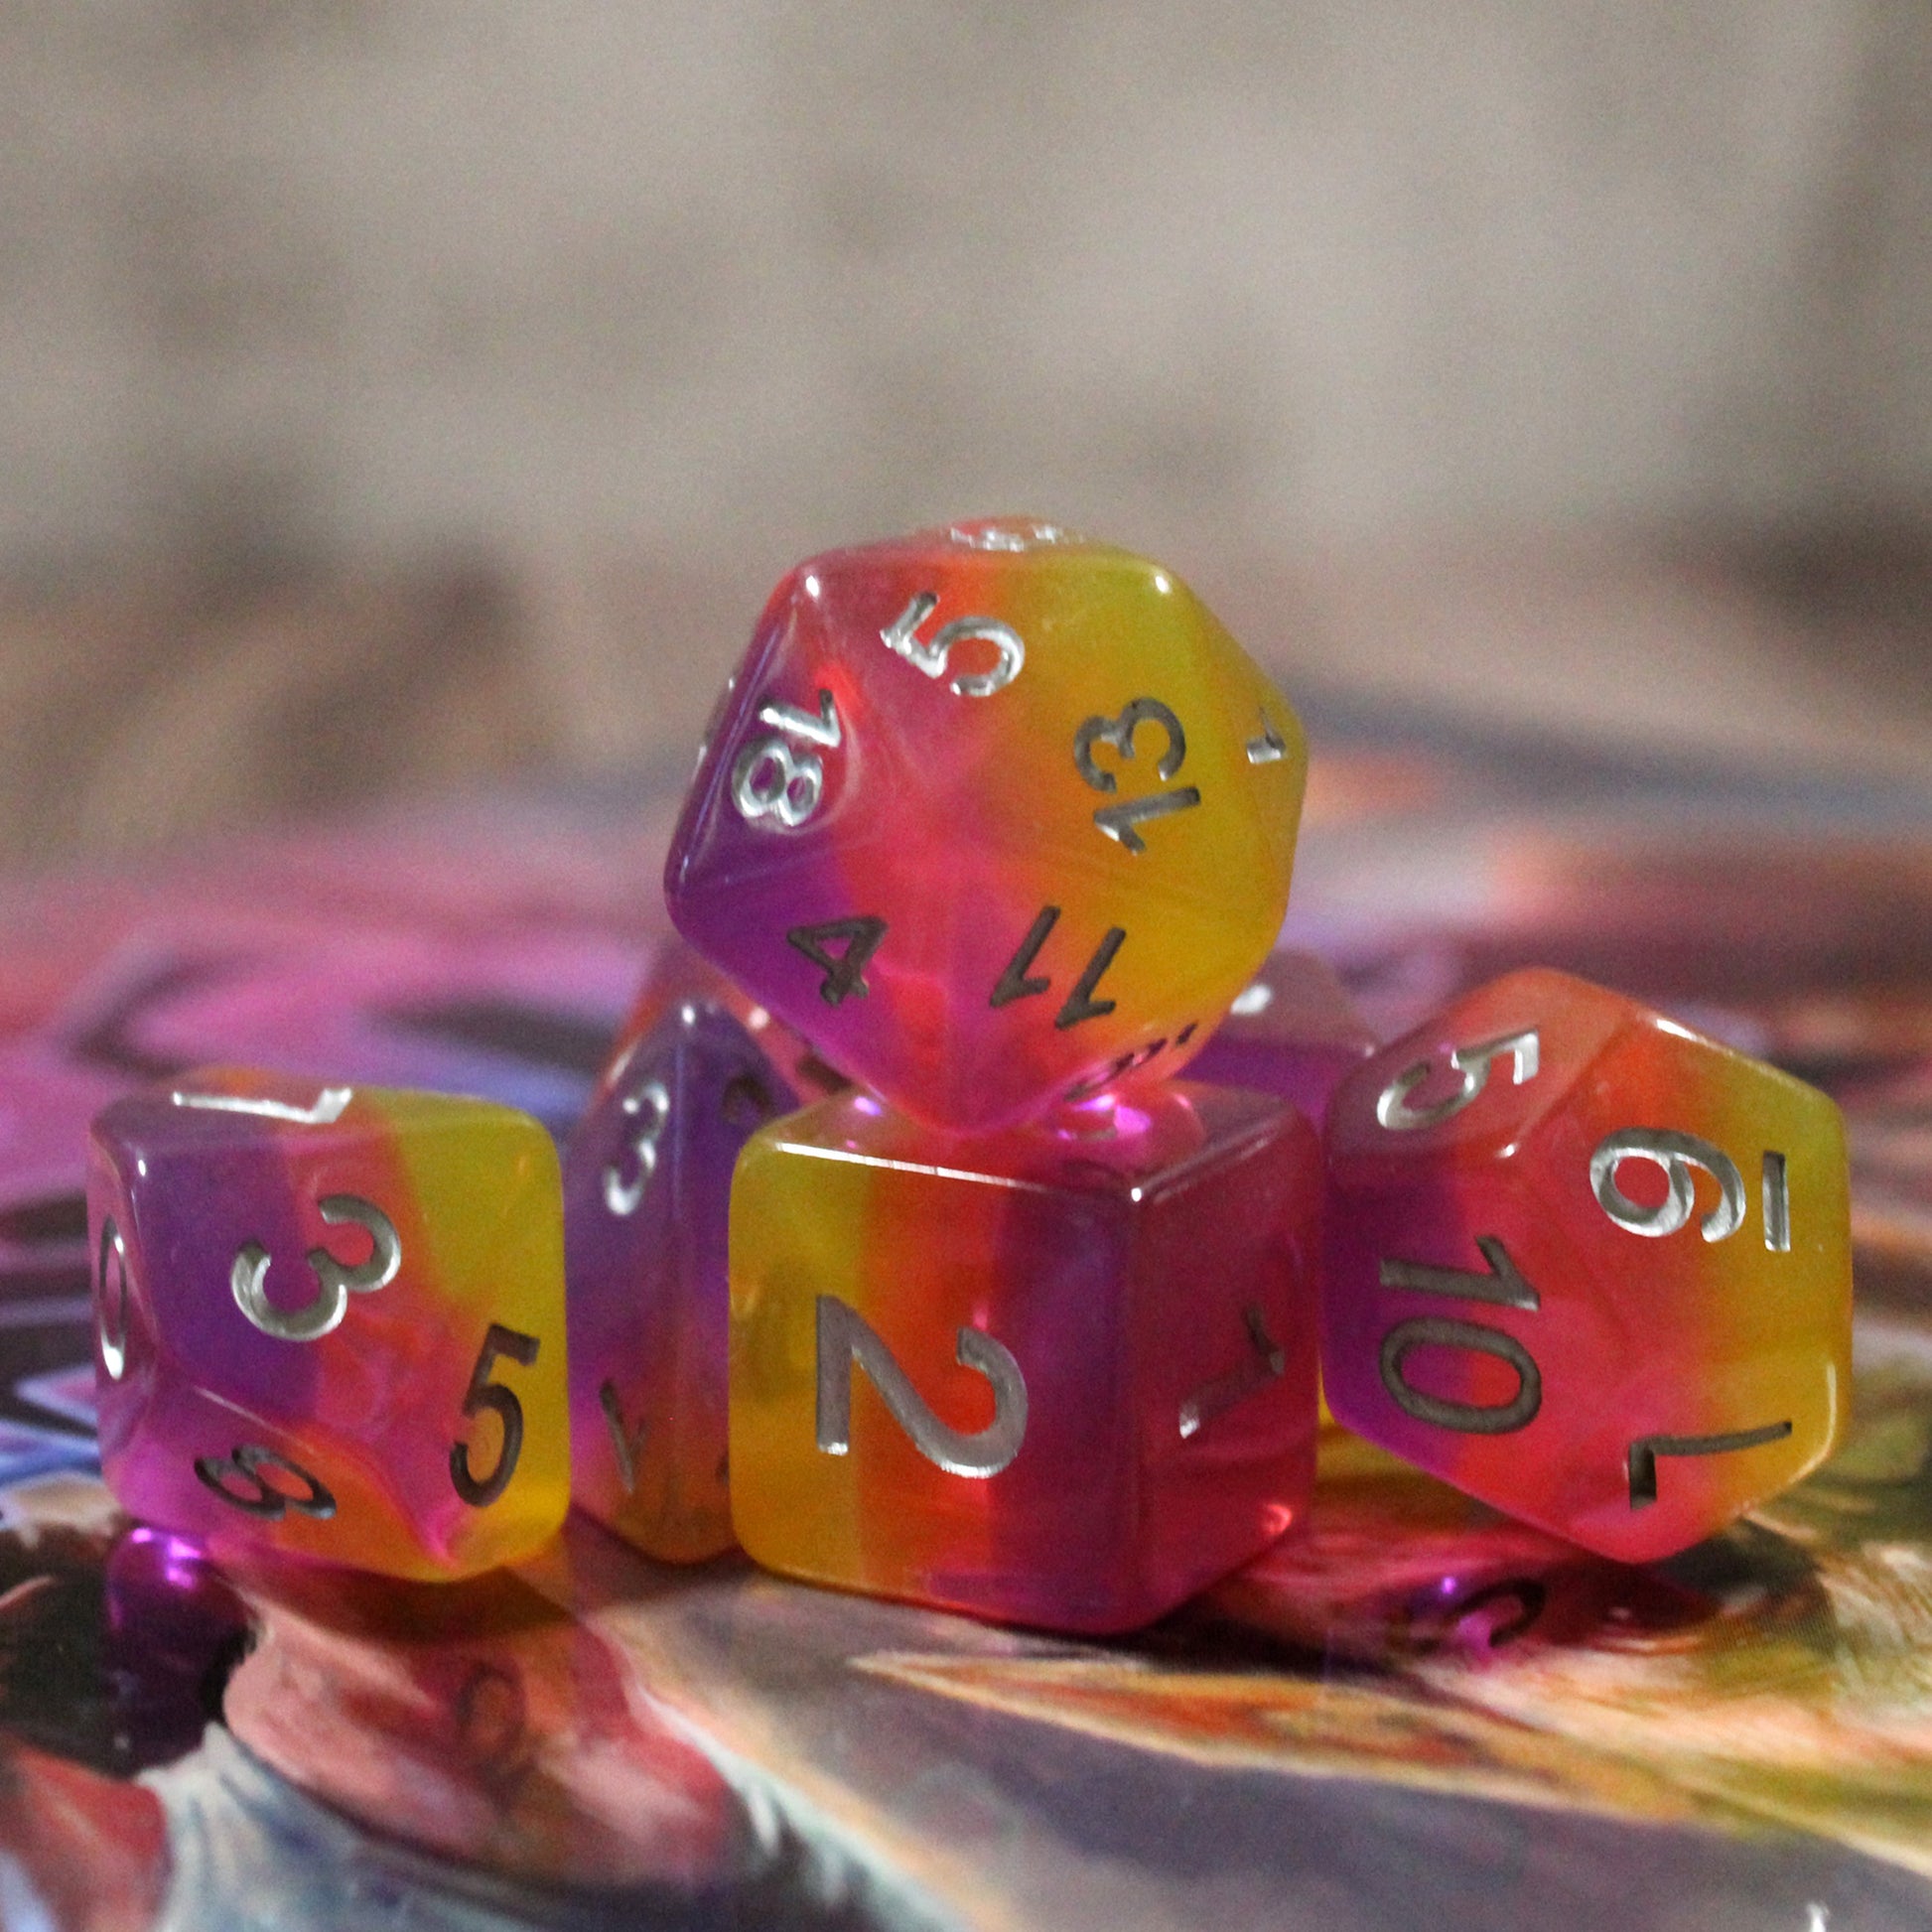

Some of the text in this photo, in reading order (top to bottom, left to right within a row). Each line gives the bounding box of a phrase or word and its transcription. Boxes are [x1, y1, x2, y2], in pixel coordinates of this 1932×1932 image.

[881, 592, 1025, 696] 5
[732, 689, 842, 827] 18
[1074, 697, 1201, 854] 13
[787, 915, 887, 1008] 4
[990, 905, 1127, 1031] 11
[1377, 1029, 1540, 1131] 5
[231, 1193, 401, 1341] 3
[816, 1295, 1029, 1479] 2
[1379, 1235, 1543, 1435] 10
[450, 1322, 540, 1507] 5
[1629, 1421, 1793, 1511] 7
[195, 1445, 337, 1522] 8
